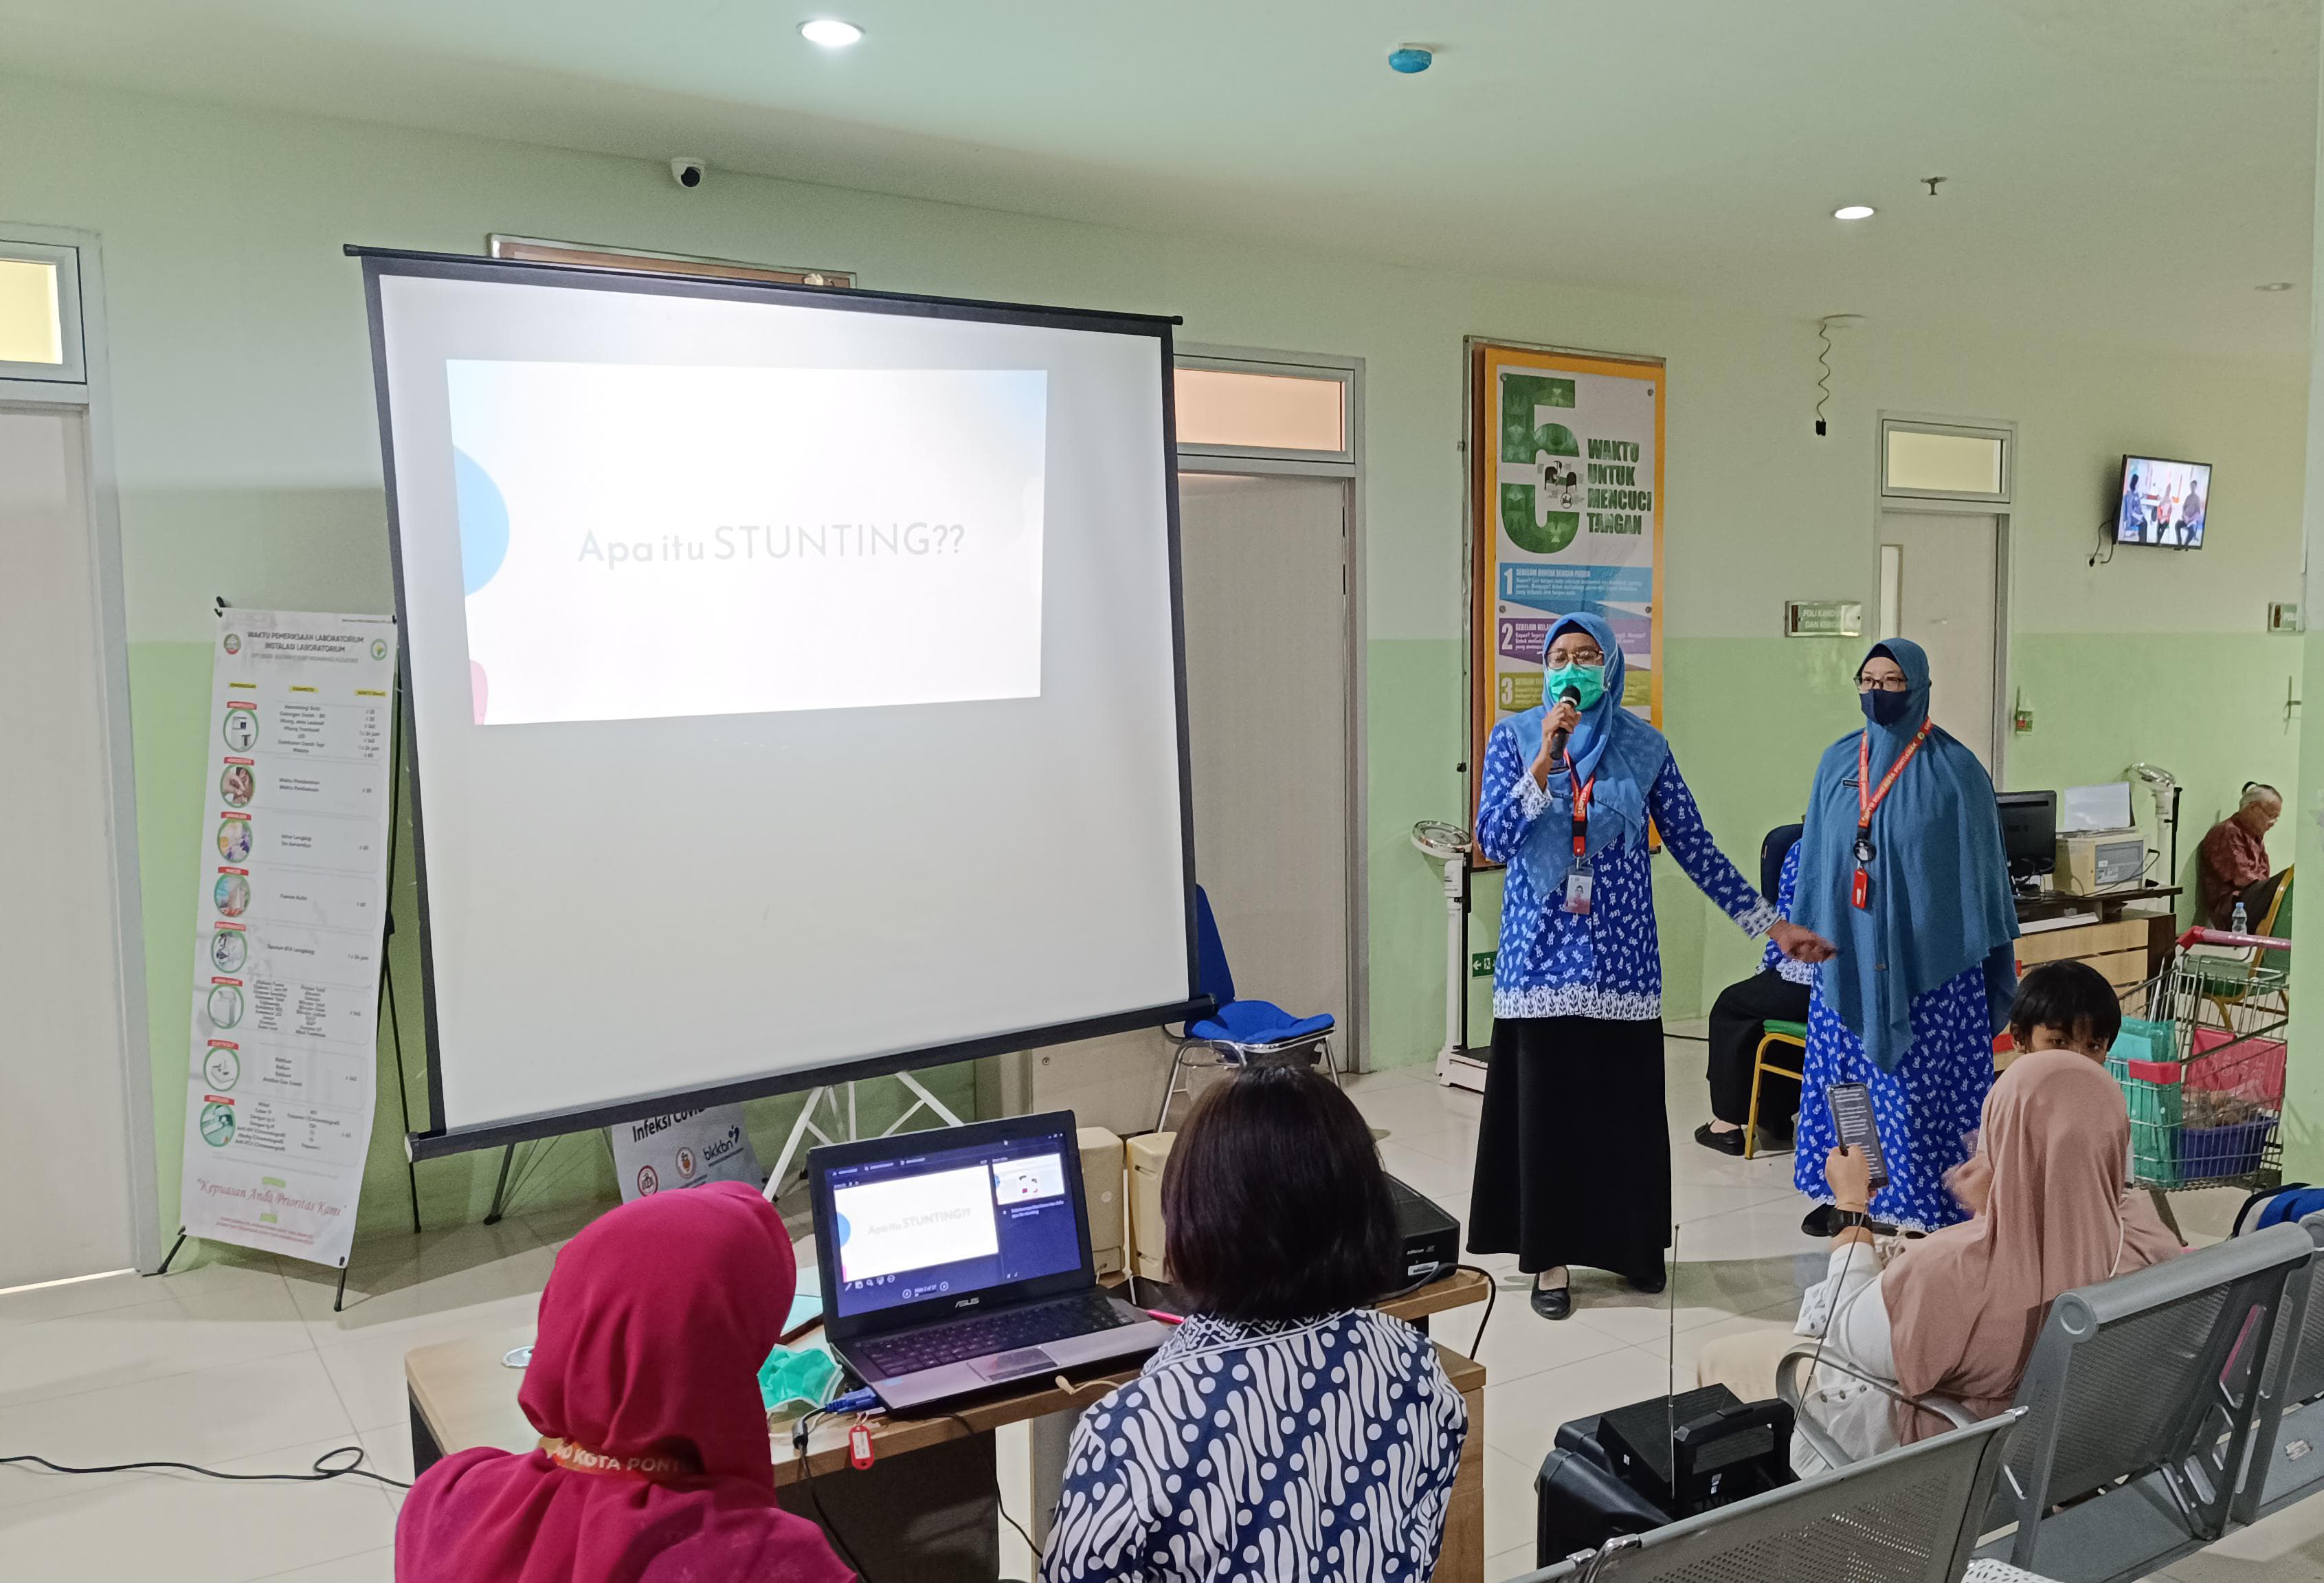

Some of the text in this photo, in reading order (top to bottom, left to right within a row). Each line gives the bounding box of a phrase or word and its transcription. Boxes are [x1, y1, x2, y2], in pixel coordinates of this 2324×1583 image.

[1587, 439, 1640, 463] WAKTU
[1587, 463, 1635, 486] UNTUK
[1587, 488, 1652, 511] MENCUCI
[1587, 512, 1642, 535] TANGAN
[578, 522, 965, 570] Apa itu STUNTING??
[1504, 568, 1513, 595] 1
[1501, 623, 1513, 650] 2
[1501, 677, 1513, 705] 3
[247, 1188, 274, 1204] Anda
[275, 1193, 315, 1211] Prioritas
[954, 1297, 980, 1308] ASUS
[573, 1449, 622, 1471] KOTA
